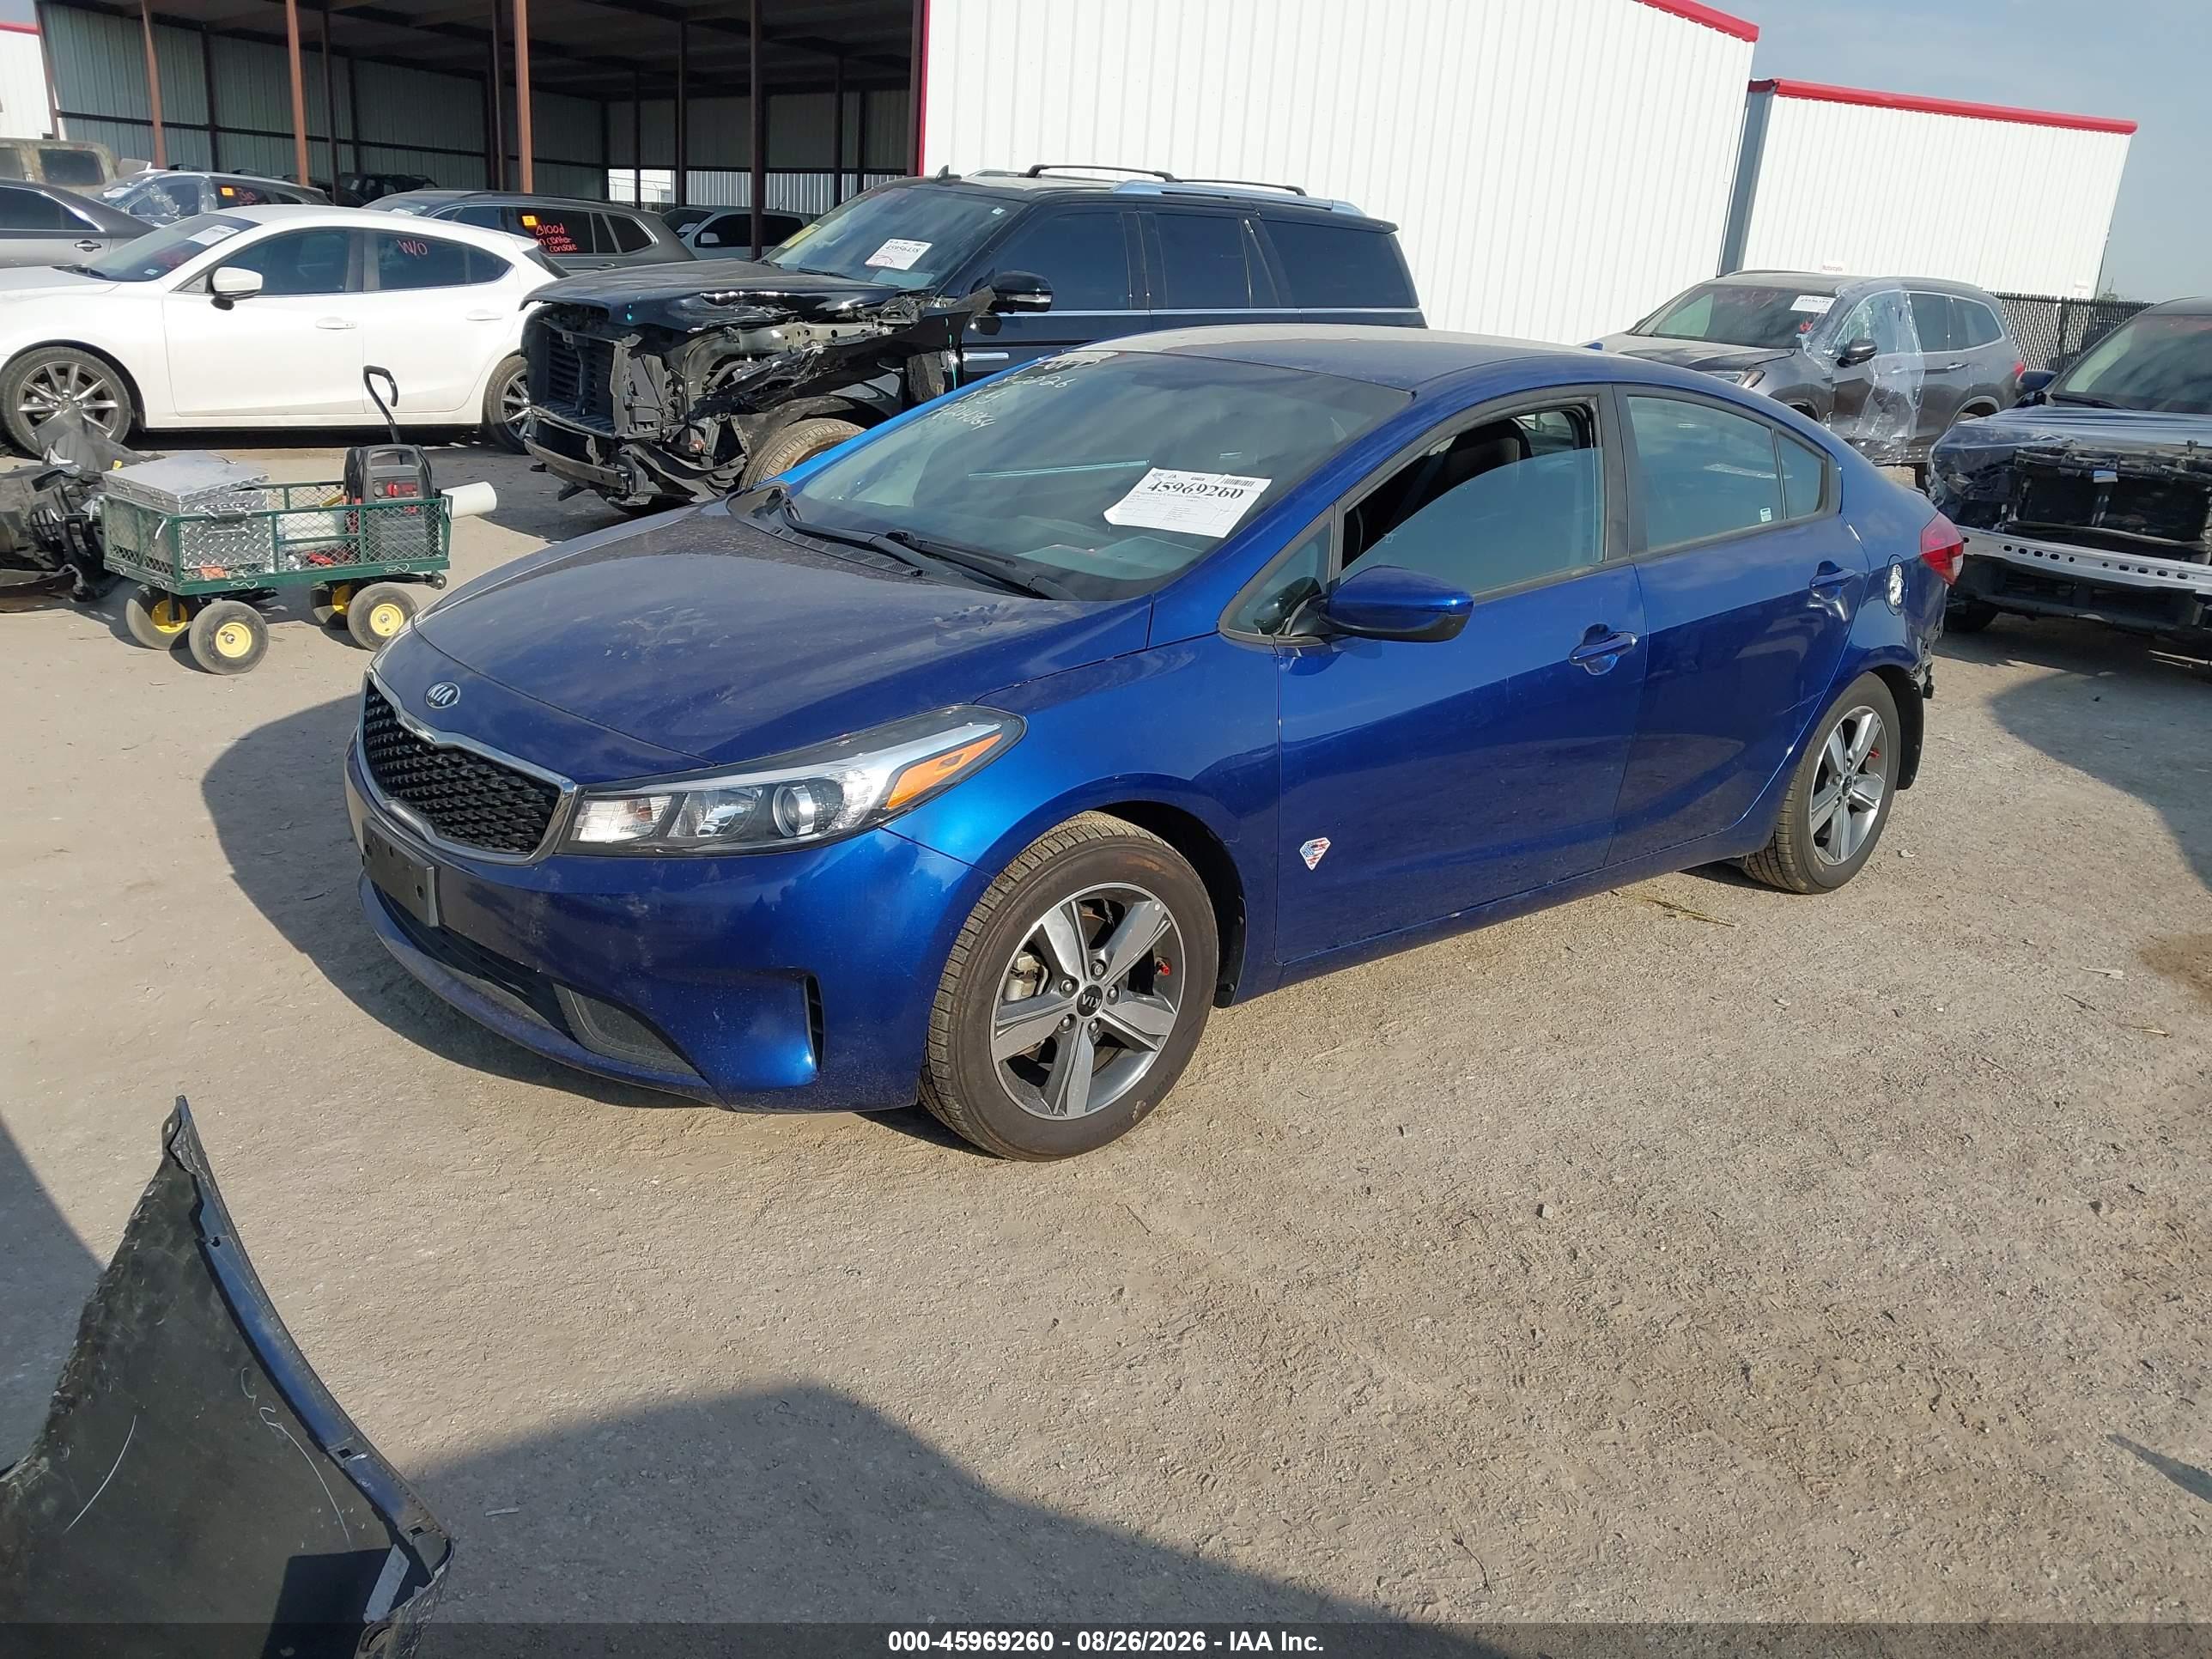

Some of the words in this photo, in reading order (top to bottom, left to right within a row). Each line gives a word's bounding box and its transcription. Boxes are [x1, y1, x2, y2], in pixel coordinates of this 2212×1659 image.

[536, 223, 564, 235] Blood
[550, 244, 577, 252] console
[1146, 481, 1244, 499] 45969260
[428, 684, 454, 705] KIA
